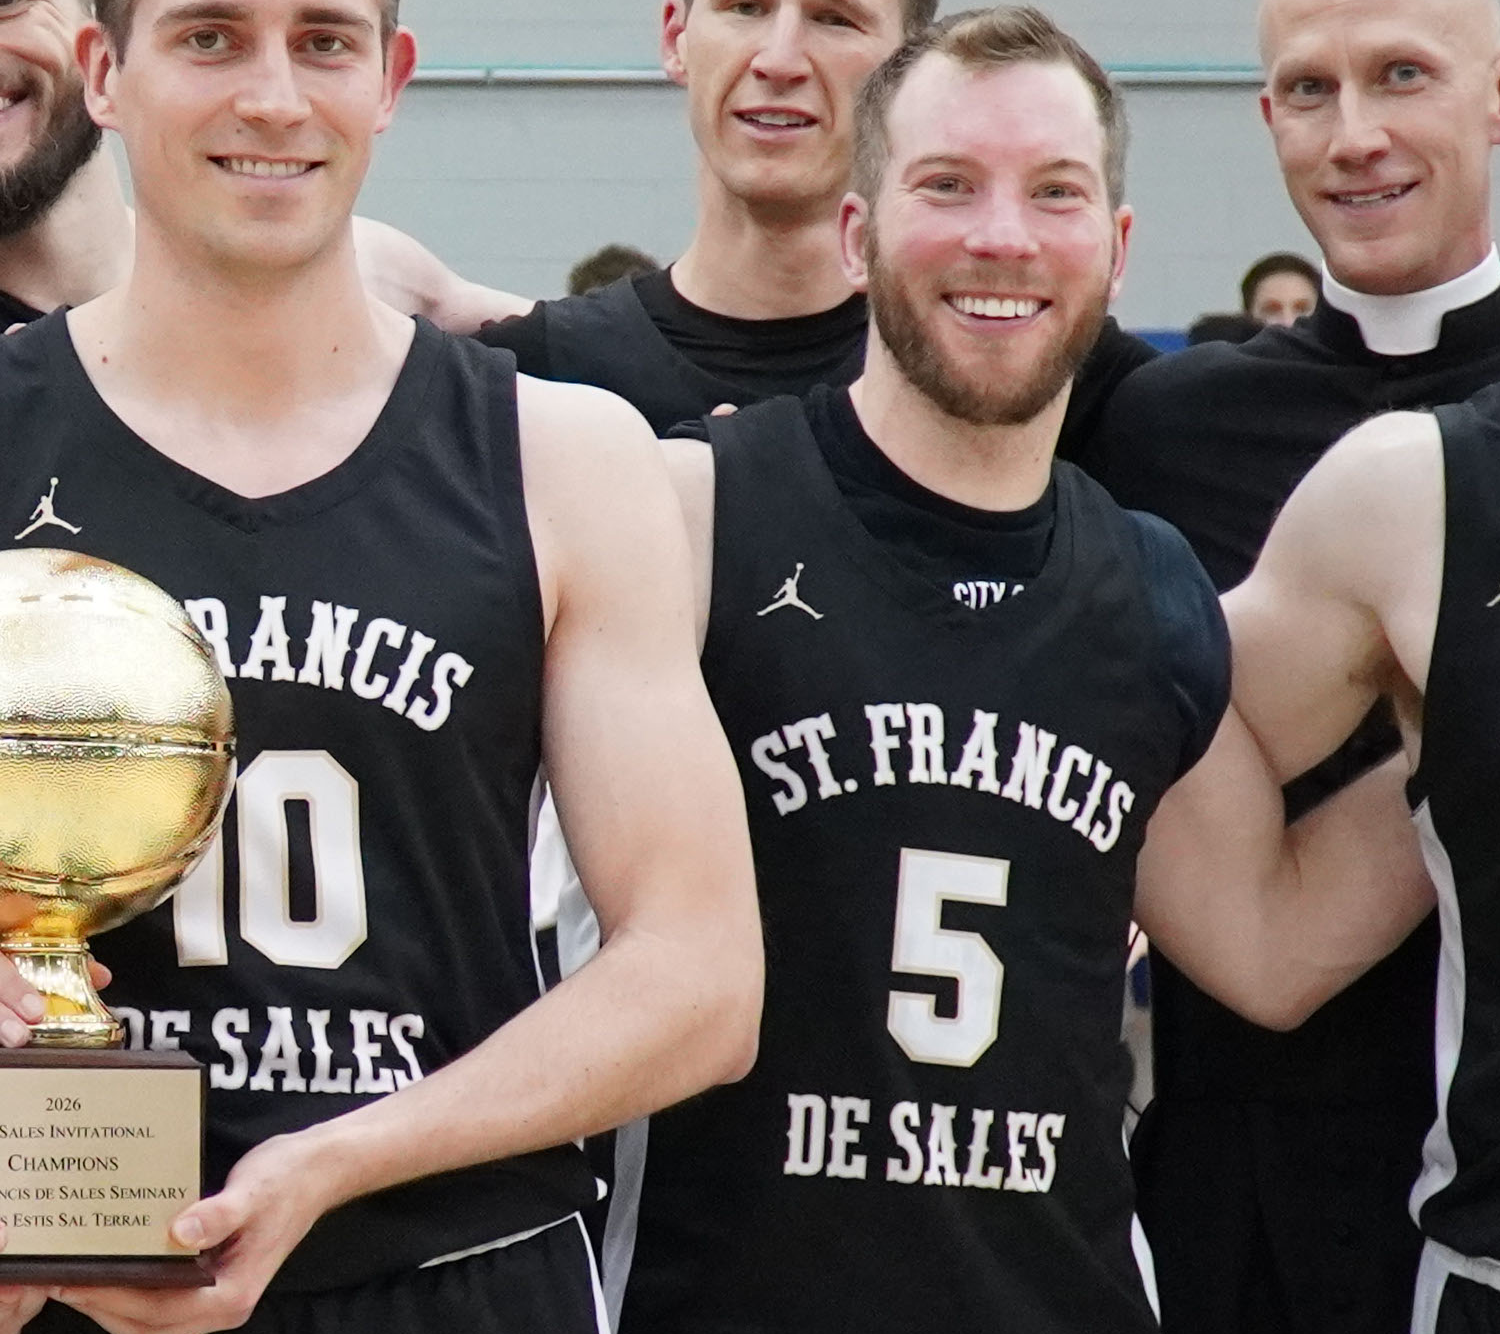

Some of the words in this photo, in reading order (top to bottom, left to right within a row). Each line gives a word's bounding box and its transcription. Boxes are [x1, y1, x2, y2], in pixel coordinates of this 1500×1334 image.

[953, 580, 1006, 610] CITY
[751, 713, 858, 816] ST.
[865, 703, 1135, 853] FRANCIS
[887, 847, 1010, 1068] 5
[210, 1006, 426, 1094] SALES
[45, 1097, 82, 1112] 2026
[50, 1125, 155, 1139] INVITATIONAL
[784, 1094, 870, 1179] DE
[887, 1100, 1066, 1193] SALES
[7, 1154, 119, 1172] CHAMPIONS
[59, 1186, 106, 1200] SALES
[110, 1186, 188, 1200] SEMINARY
[13, 1213, 54, 1227] ESTIS
[58, 1213, 88, 1227] SAL
[92, 1213, 151, 1227] TERRAE
